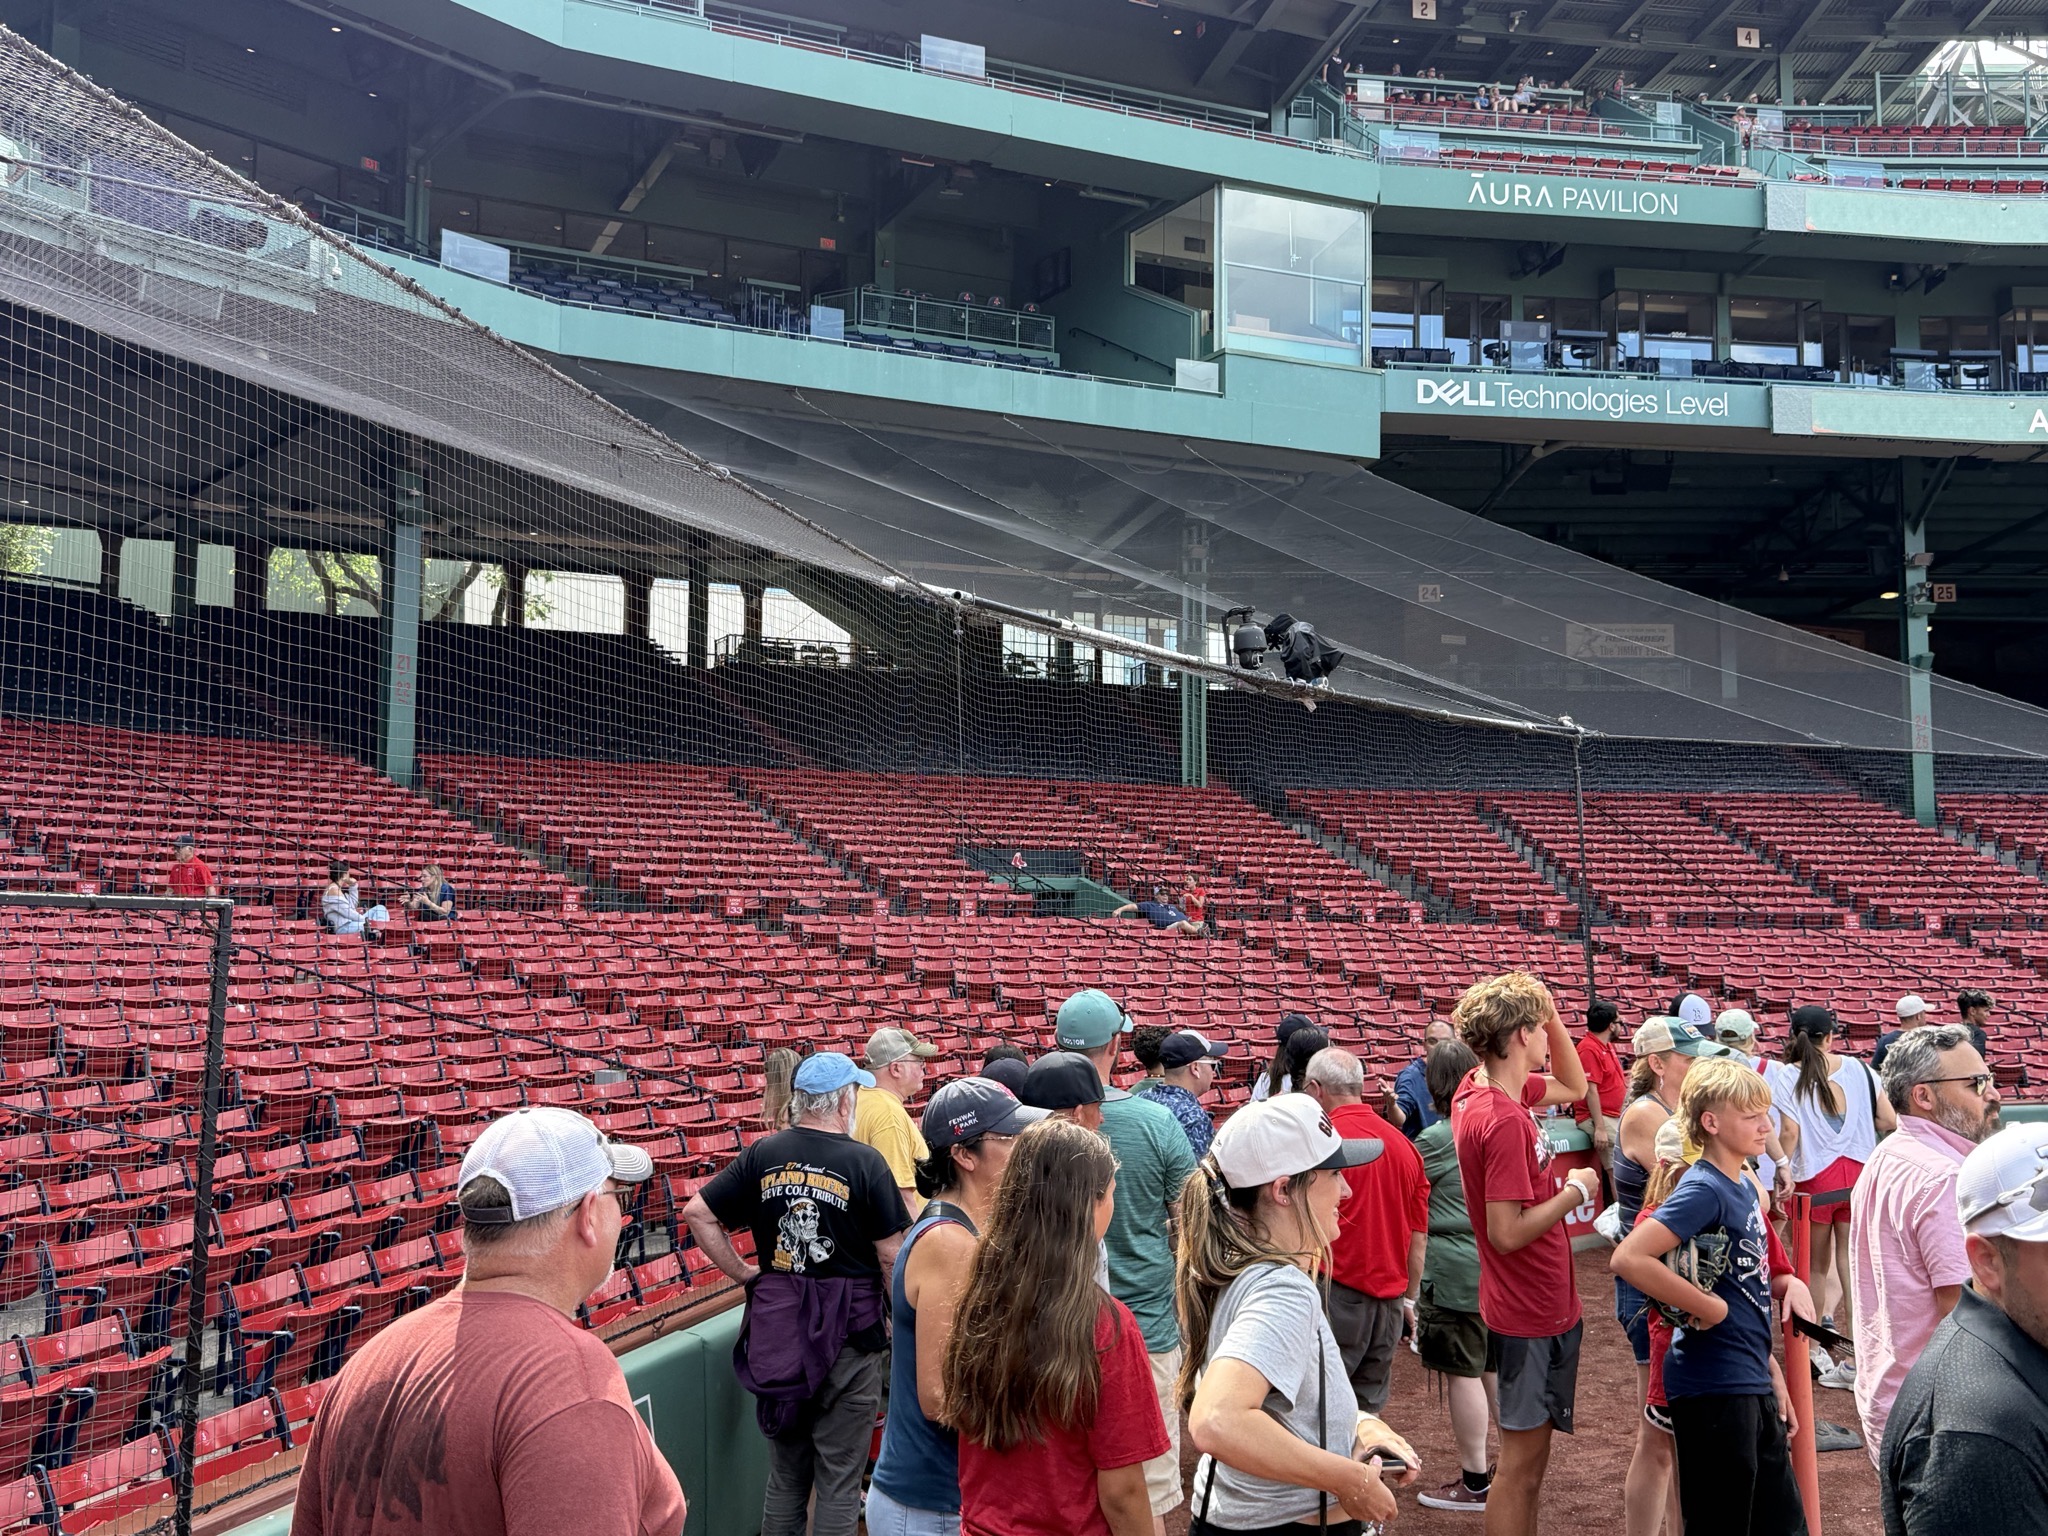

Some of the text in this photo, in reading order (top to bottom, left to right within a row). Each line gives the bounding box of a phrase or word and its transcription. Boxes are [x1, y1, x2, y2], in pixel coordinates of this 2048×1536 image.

[1420, 2, 1428, 16] 2
[1745, 31, 1752, 45] 4
[1563, 187, 1678, 216] PAVILION
[1417, 378, 1729, 419] DELL Technologies Level
[1422, 587, 1438, 600] 24
[1937, 586, 1953, 600] 25
[563, 903, 579, 912] 132
[727, 906, 743, 914] 133
[948, 1109, 977, 1127] FENWAY
[959, 1116, 979, 1129] PARK
[785, 1184, 810, 1197] COLE
[812, 1187, 848, 1212] TRIBUTE
[1737, 1257, 1755, 1267] EST.
